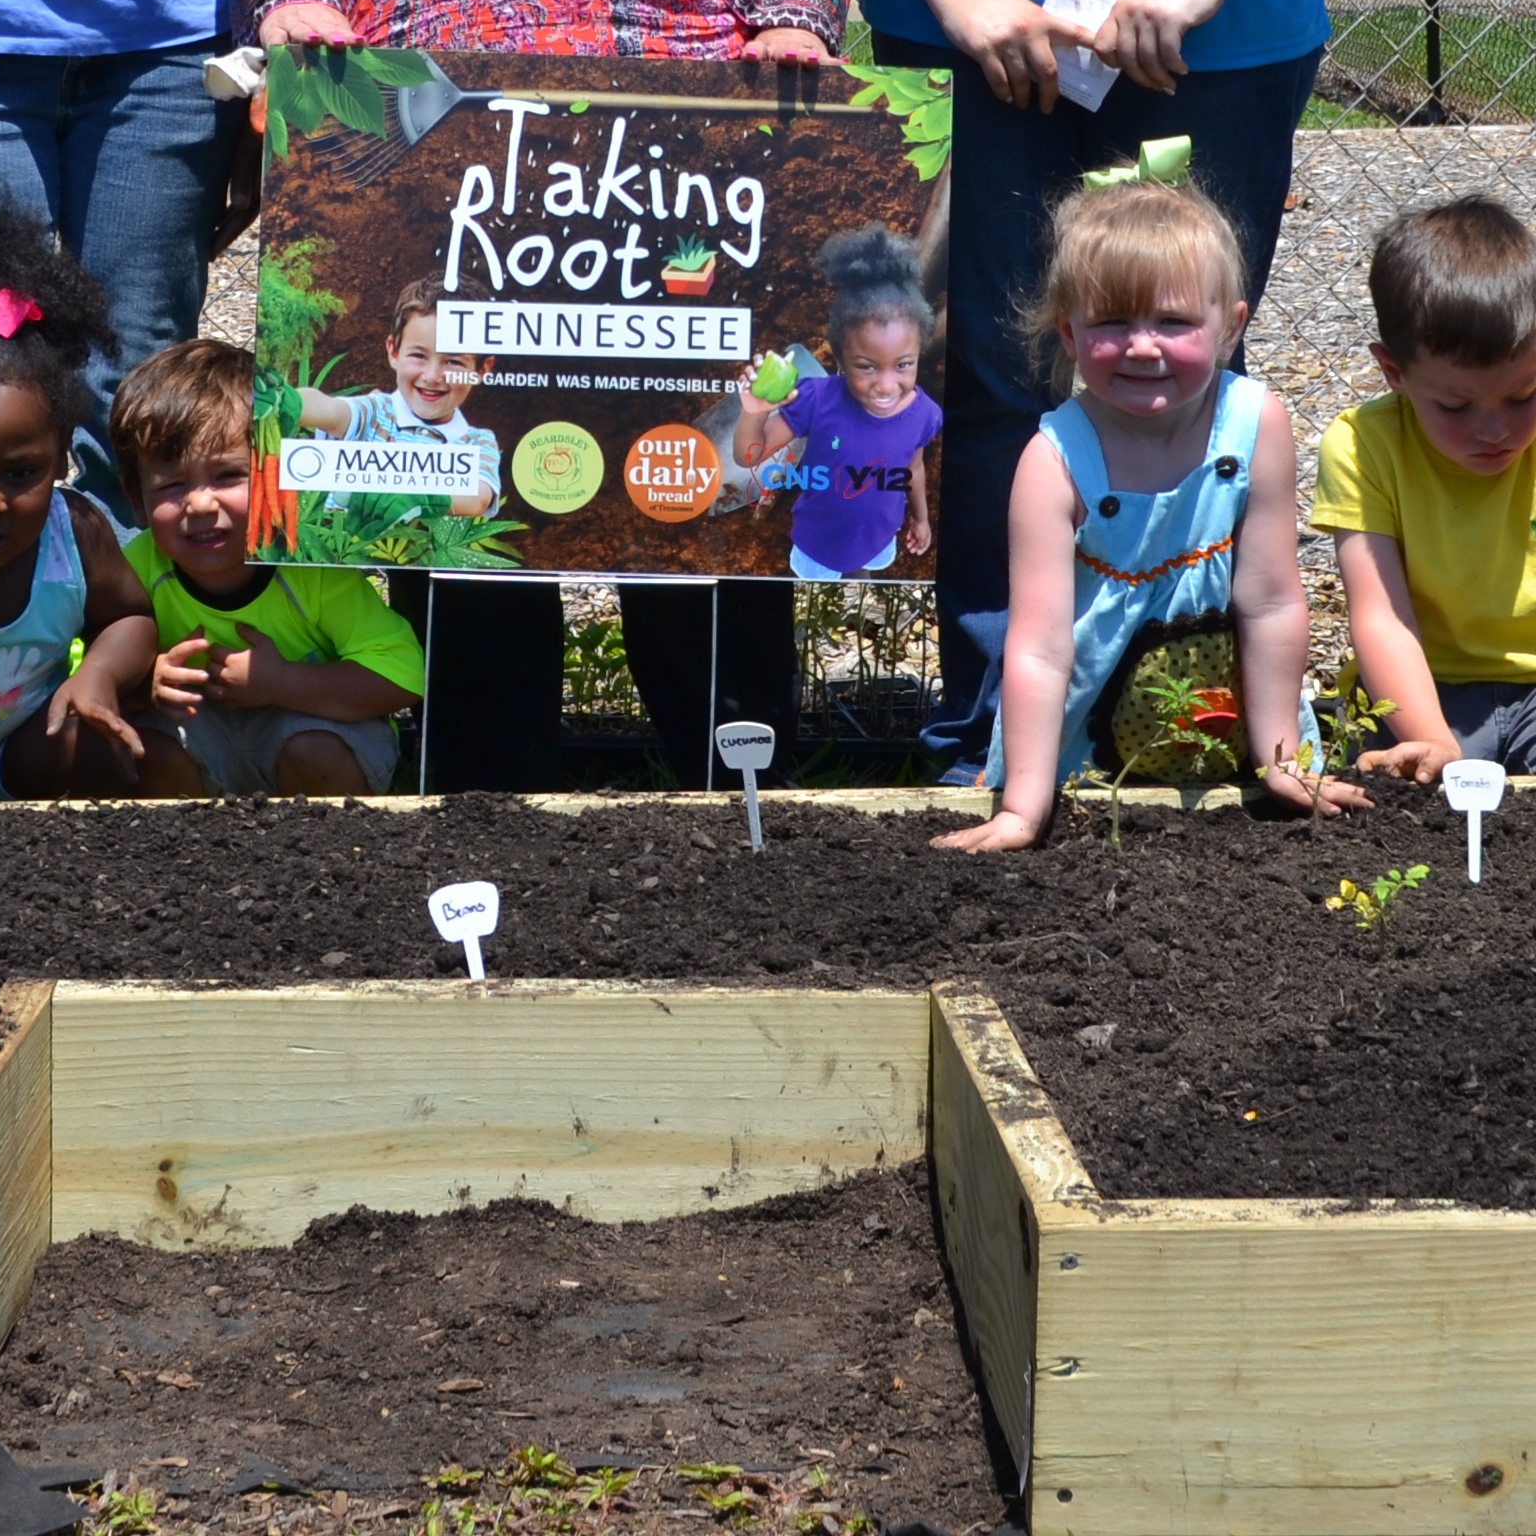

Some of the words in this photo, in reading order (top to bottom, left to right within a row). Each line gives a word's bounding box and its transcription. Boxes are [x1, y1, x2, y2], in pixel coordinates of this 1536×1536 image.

[487, 98, 764, 268] Taking
[443, 165, 652, 299] Root
[449, 310, 738, 351] TENNESSEE
[444, 371, 479, 385] THIS
[482, 373, 549, 387] GARDEN
[556, 375, 591, 389] WAS
[594, 376, 640, 390] MADE
[643, 377, 722, 393] POSSIBLE
[637, 439, 687, 456] our
[335, 449, 472, 474] MAXIMUS
[628, 448, 718, 493] daily
[335, 473, 470, 487] FOUNDATION
[761, 465, 830, 491] CNS
[647, 487, 694, 503] bread
[1450, 775, 1492, 789] Tomato
[442, 902, 486, 921] Beans
